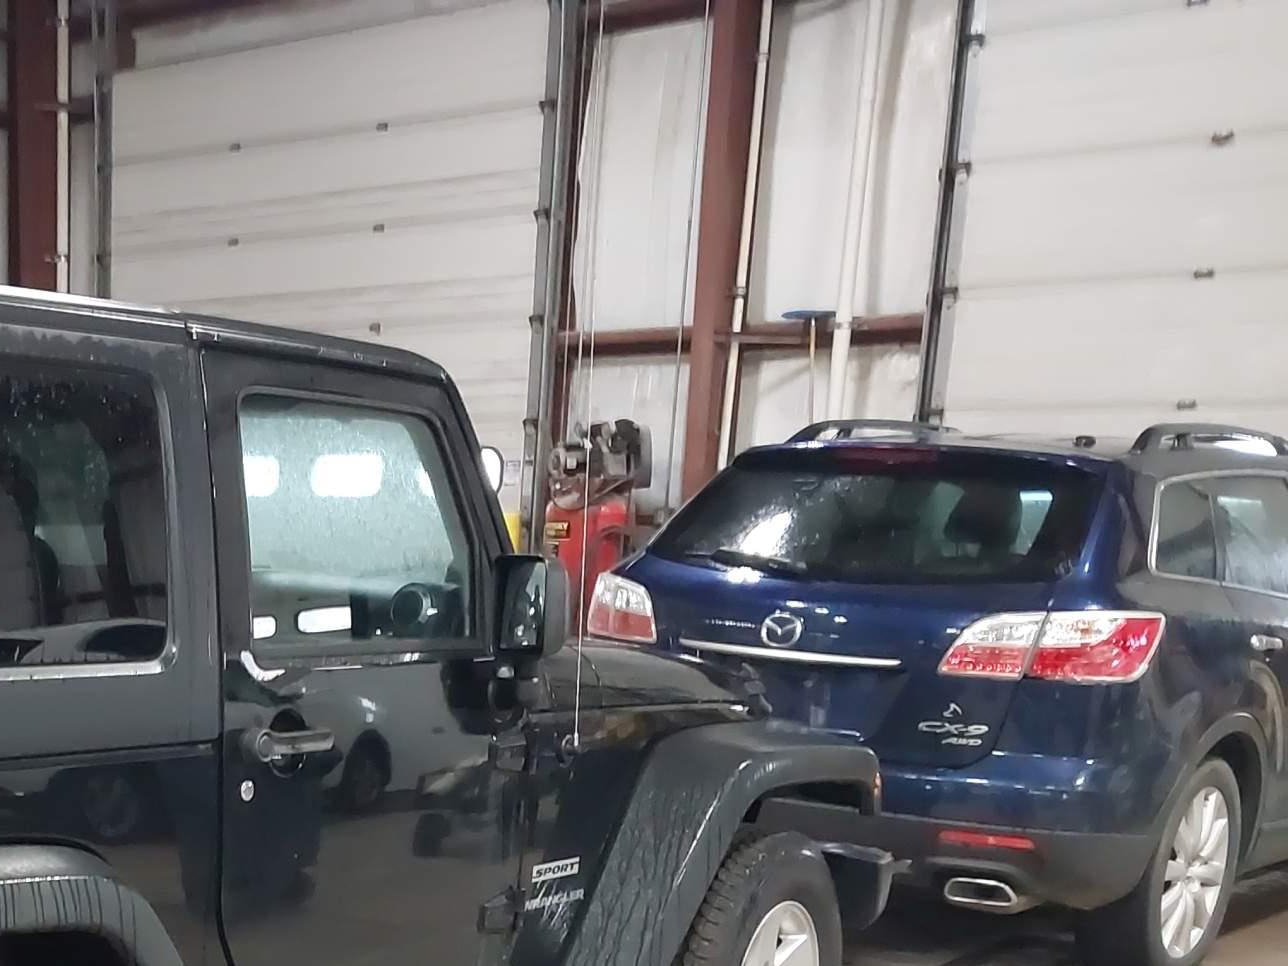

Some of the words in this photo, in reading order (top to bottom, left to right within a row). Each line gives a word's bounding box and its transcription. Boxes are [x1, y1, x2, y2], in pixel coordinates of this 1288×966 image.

[917, 721, 990, 737] CX-9
[941, 737, 983, 746] AWD
[535, 862, 577, 879] SPORT
